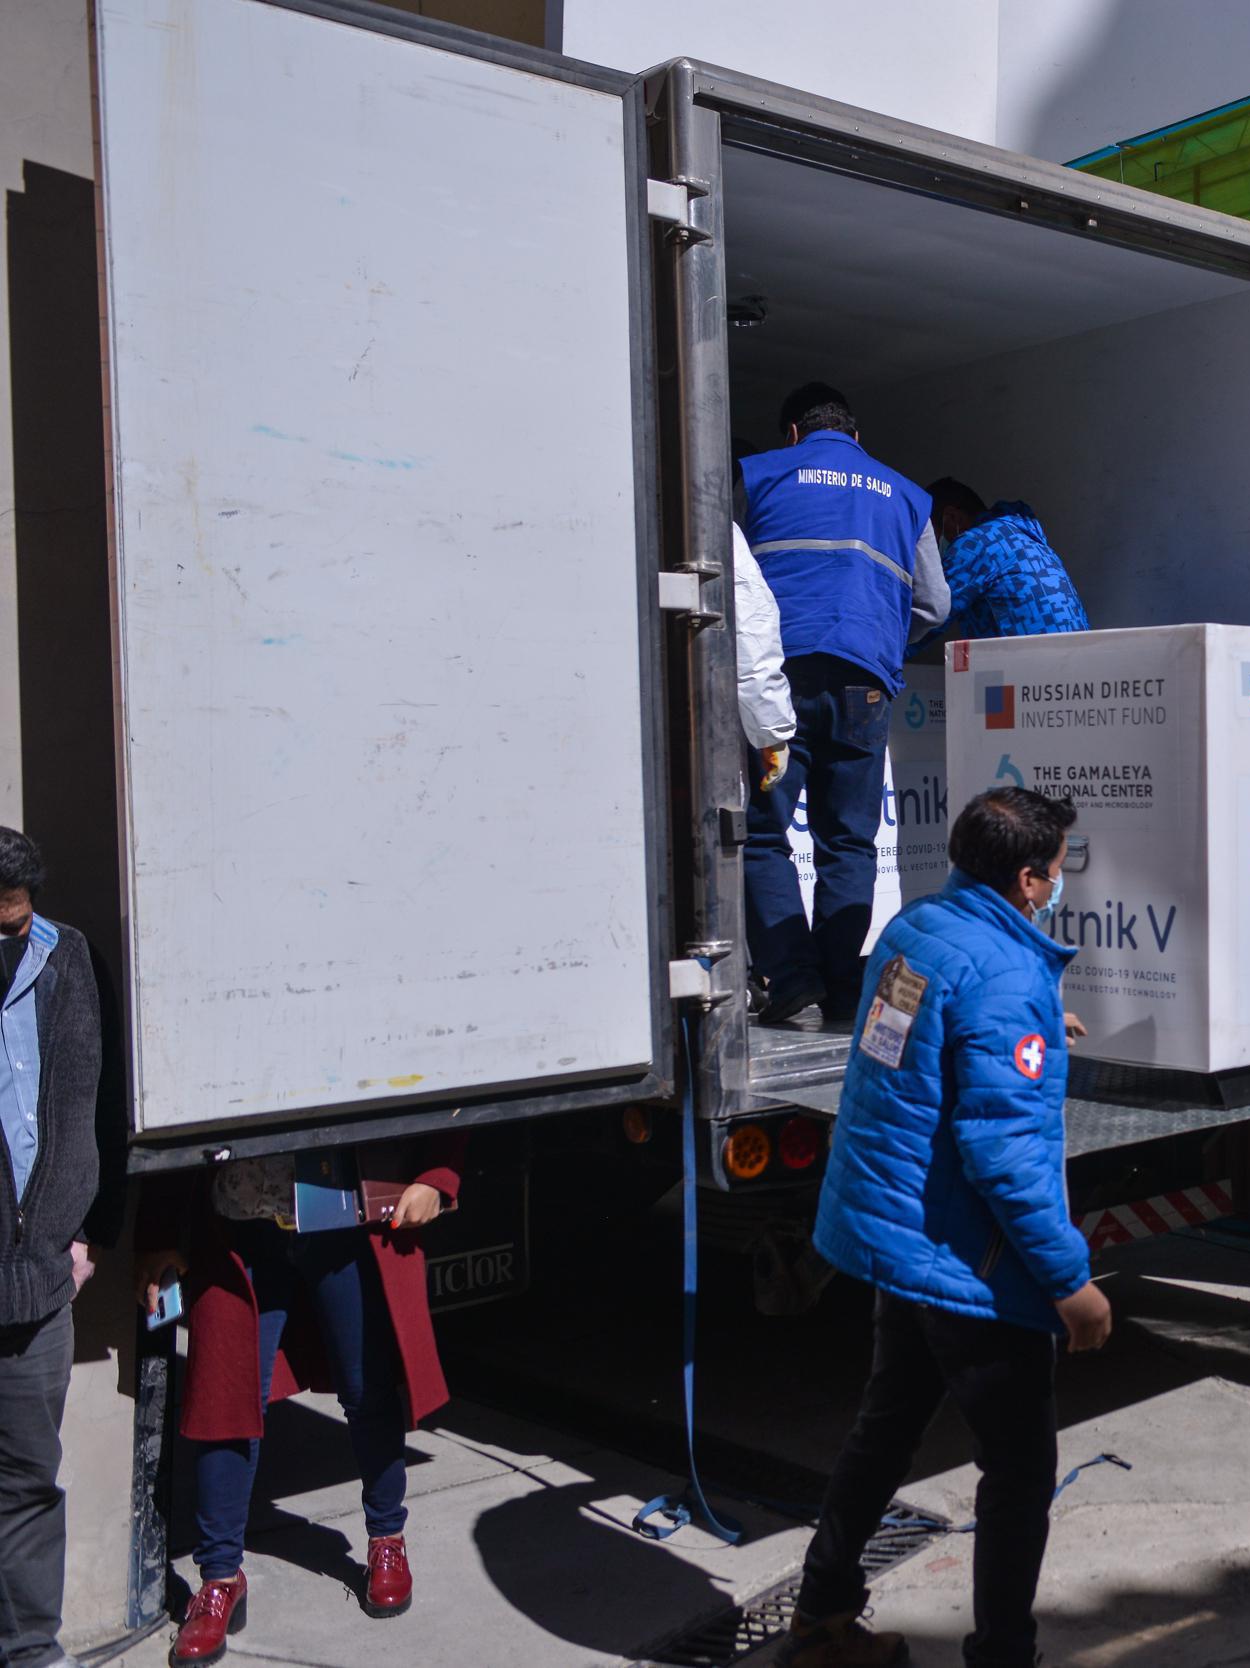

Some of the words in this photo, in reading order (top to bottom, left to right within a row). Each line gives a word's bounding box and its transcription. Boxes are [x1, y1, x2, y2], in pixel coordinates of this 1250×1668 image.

[798, 469, 847, 487] MINISTERIO
[851, 473, 863, 488] DE
[866, 476, 892, 498] SALUD
[1021, 682, 1095, 702] RUSSIAN
[1101, 678, 1165, 699] DIRECT
[1021, 707, 1117, 729] INVESTMENT
[1121, 706, 1167, 726] FUND
[1033, 766, 1062, 781] THE
[1066, 765, 1153, 780] GAMALEYA
[1101, 784, 1153, 798] CENTER
[792, 853, 812, 863] THE
[906, 843, 946, 856] COVID-19
[911, 862, 938, 871] VECTOR
[1147, 904, 1177, 953] V
[1085, 965, 1130, 979] COVID-19
[1132, 970, 1177, 984] VACCINE
[1089, 985, 1119, 995] VECTOR
[1123, 987, 1177, 1000] TECHNOLOGY
[427, 1252, 515, 1297] ICTOR
